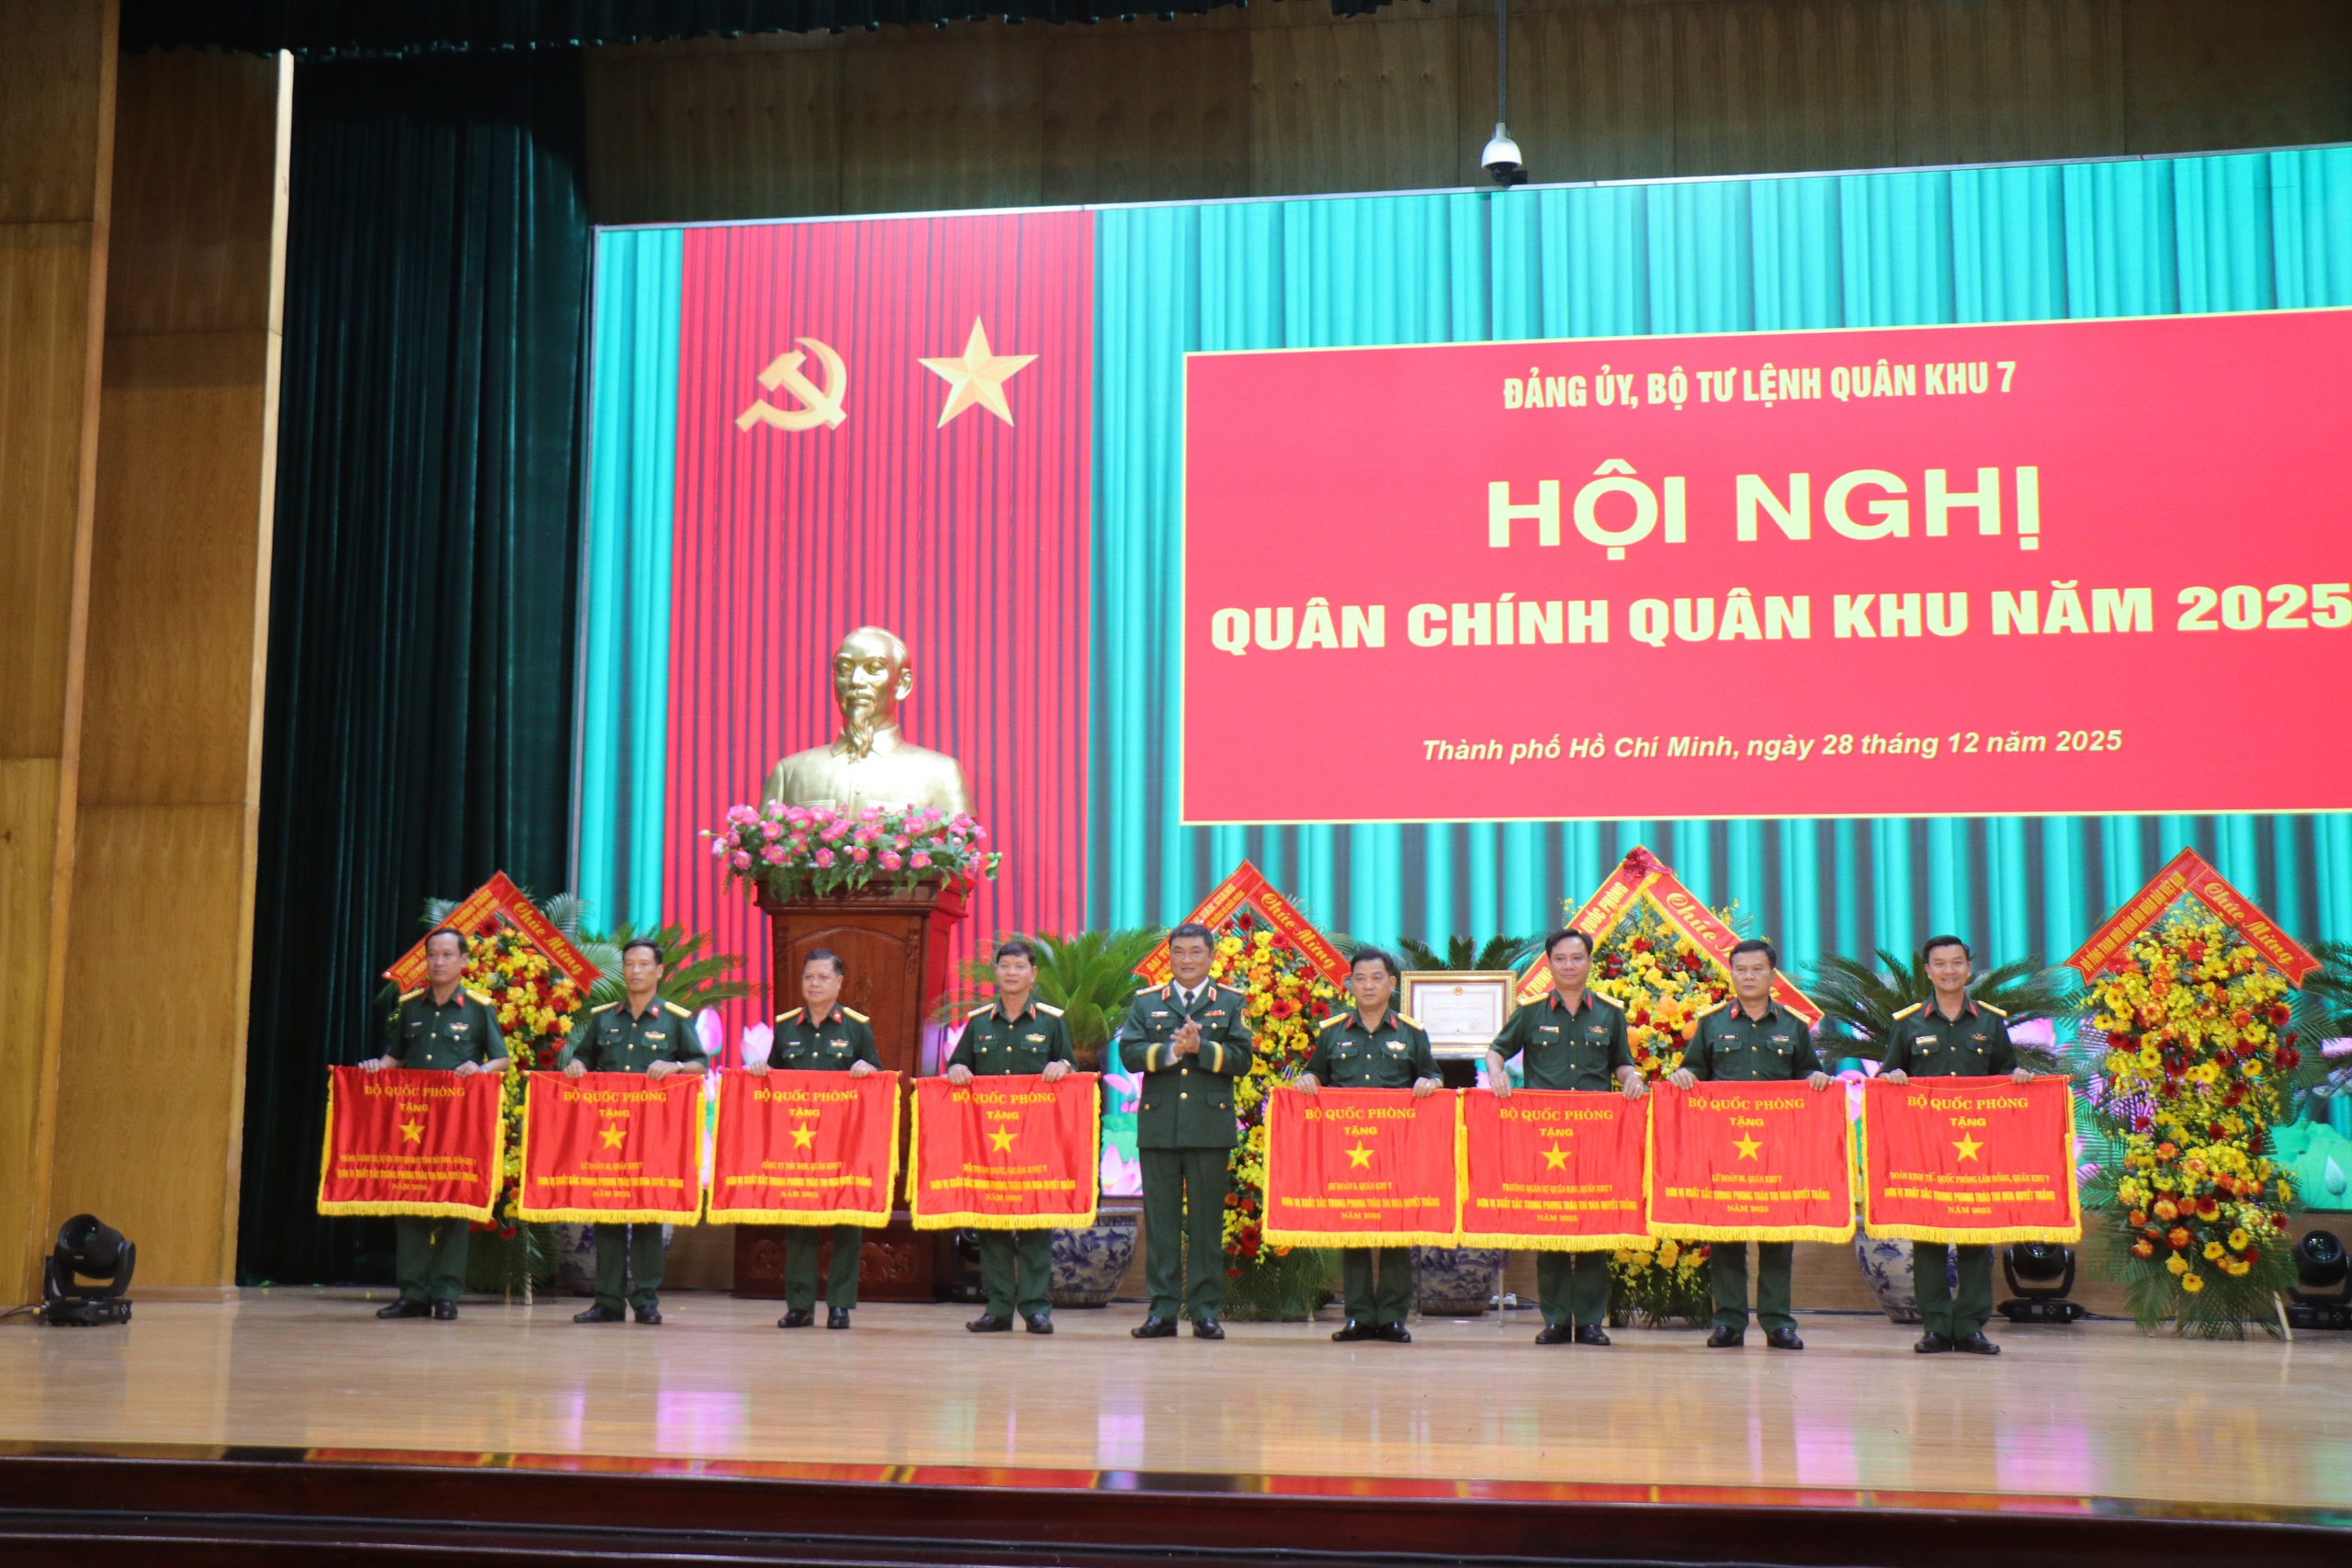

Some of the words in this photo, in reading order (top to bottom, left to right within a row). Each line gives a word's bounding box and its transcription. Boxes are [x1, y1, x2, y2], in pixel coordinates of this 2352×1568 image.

[1503, 367, 1587, 409] ĐẢNG
[1596, 365, 1638, 409] ỦY,
[1647, 366, 1688, 411] BỘ
[1696, 367, 1736, 402] TƯ
[1744, 363, 1821, 408] LỆNH
[1831, 359, 1916, 401] QUÂN
[1926, 362, 1988, 395] KHU
[1997, 361, 2016, 392] 7
[1488, 458, 1686, 560] HỘI
[1736, 466, 2040, 550] NGHỊ
[1212, 597, 1385, 656] QUÂN
[1408, 592, 1609, 647] CHÍNH
[1629, 588, 1810, 647] QUÂN
[1834, 592, 1968, 637] KHU
[1992, 580, 2153, 635] NĂM
[2177, 583, 2352, 630] 2025
[1423, 739, 1503, 760] Thành
[1510, 734, 1560, 764] phố
[1569, 733, 1605, 758] Hồ
[1615, 736, 1658, 757] Chí
[1668, 736, 1738, 759] Minh,
[1747, 734, 1813, 761] ngày
[1822, 734, 1853, 754] 28
[1861, 732, 1939, 759] tháng
[1949, 732, 1979, 752] 12
[1987, 731, 2046, 752] năm
[2056, 730, 2121, 751] 2025
[1213, 883, 1237, 907] GIANG
[1579, 908, 1607, 934] QUỐC
[1666, 892, 1717, 942] Chúc
[2204, 882, 2245, 921] Chúc
[2242, 920, 2294, 965] Mừng
[1261, 892, 1295, 929] Chúc
[1295, 928, 1336, 969] Mừng
[753, 1089, 771, 1101] BỘ
[774, 1089, 809, 1101] QUỐC
[813, 1089, 857, 1101] PHÒNG
[953, 1089, 970, 1103] BỘ
[973, 1090, 1006, 1104] QUỐC
[1012, 1091, 1056, 1104] PHÒNG
[1907, 1094, 1928, 1109] BỘ
[1931, 1096, 1972, 1110] QUỐC
[1976, 1096, 2029, 1109] PHÒNG
[1689, 1097, 1707, 1111] BỘ
[1711, 1096, 1750, 1111] QUỐC
[1755, 1097, 1804, 1110] PHÒNG
[599, 1108, 630, 1119] TẶNG
[789, 1108, 820, 1118] TẶNG
[987, 1110, 1019, 1121] TẶNG
[1306, 1107, 1322, 1121] BỘ
[1326, 1107, 1363, 1121] QUỐC
[1368, 1107, 1415, 1119] PHÒNG
[1500, 1107, 1519, 1121] BỘ
[1521, 1108, 1560, 1122] QUỐC
[1565, 1108, 1613, 1120] PHÒNG
[1730, 1116, 1763, 1127] TẶNG
[1950, 1116, 1986, 1128] TẶNG
[1344, 1126, 1377, 1136] TẶNG
[1540, 1127, 1573, 1138] TẶNG
